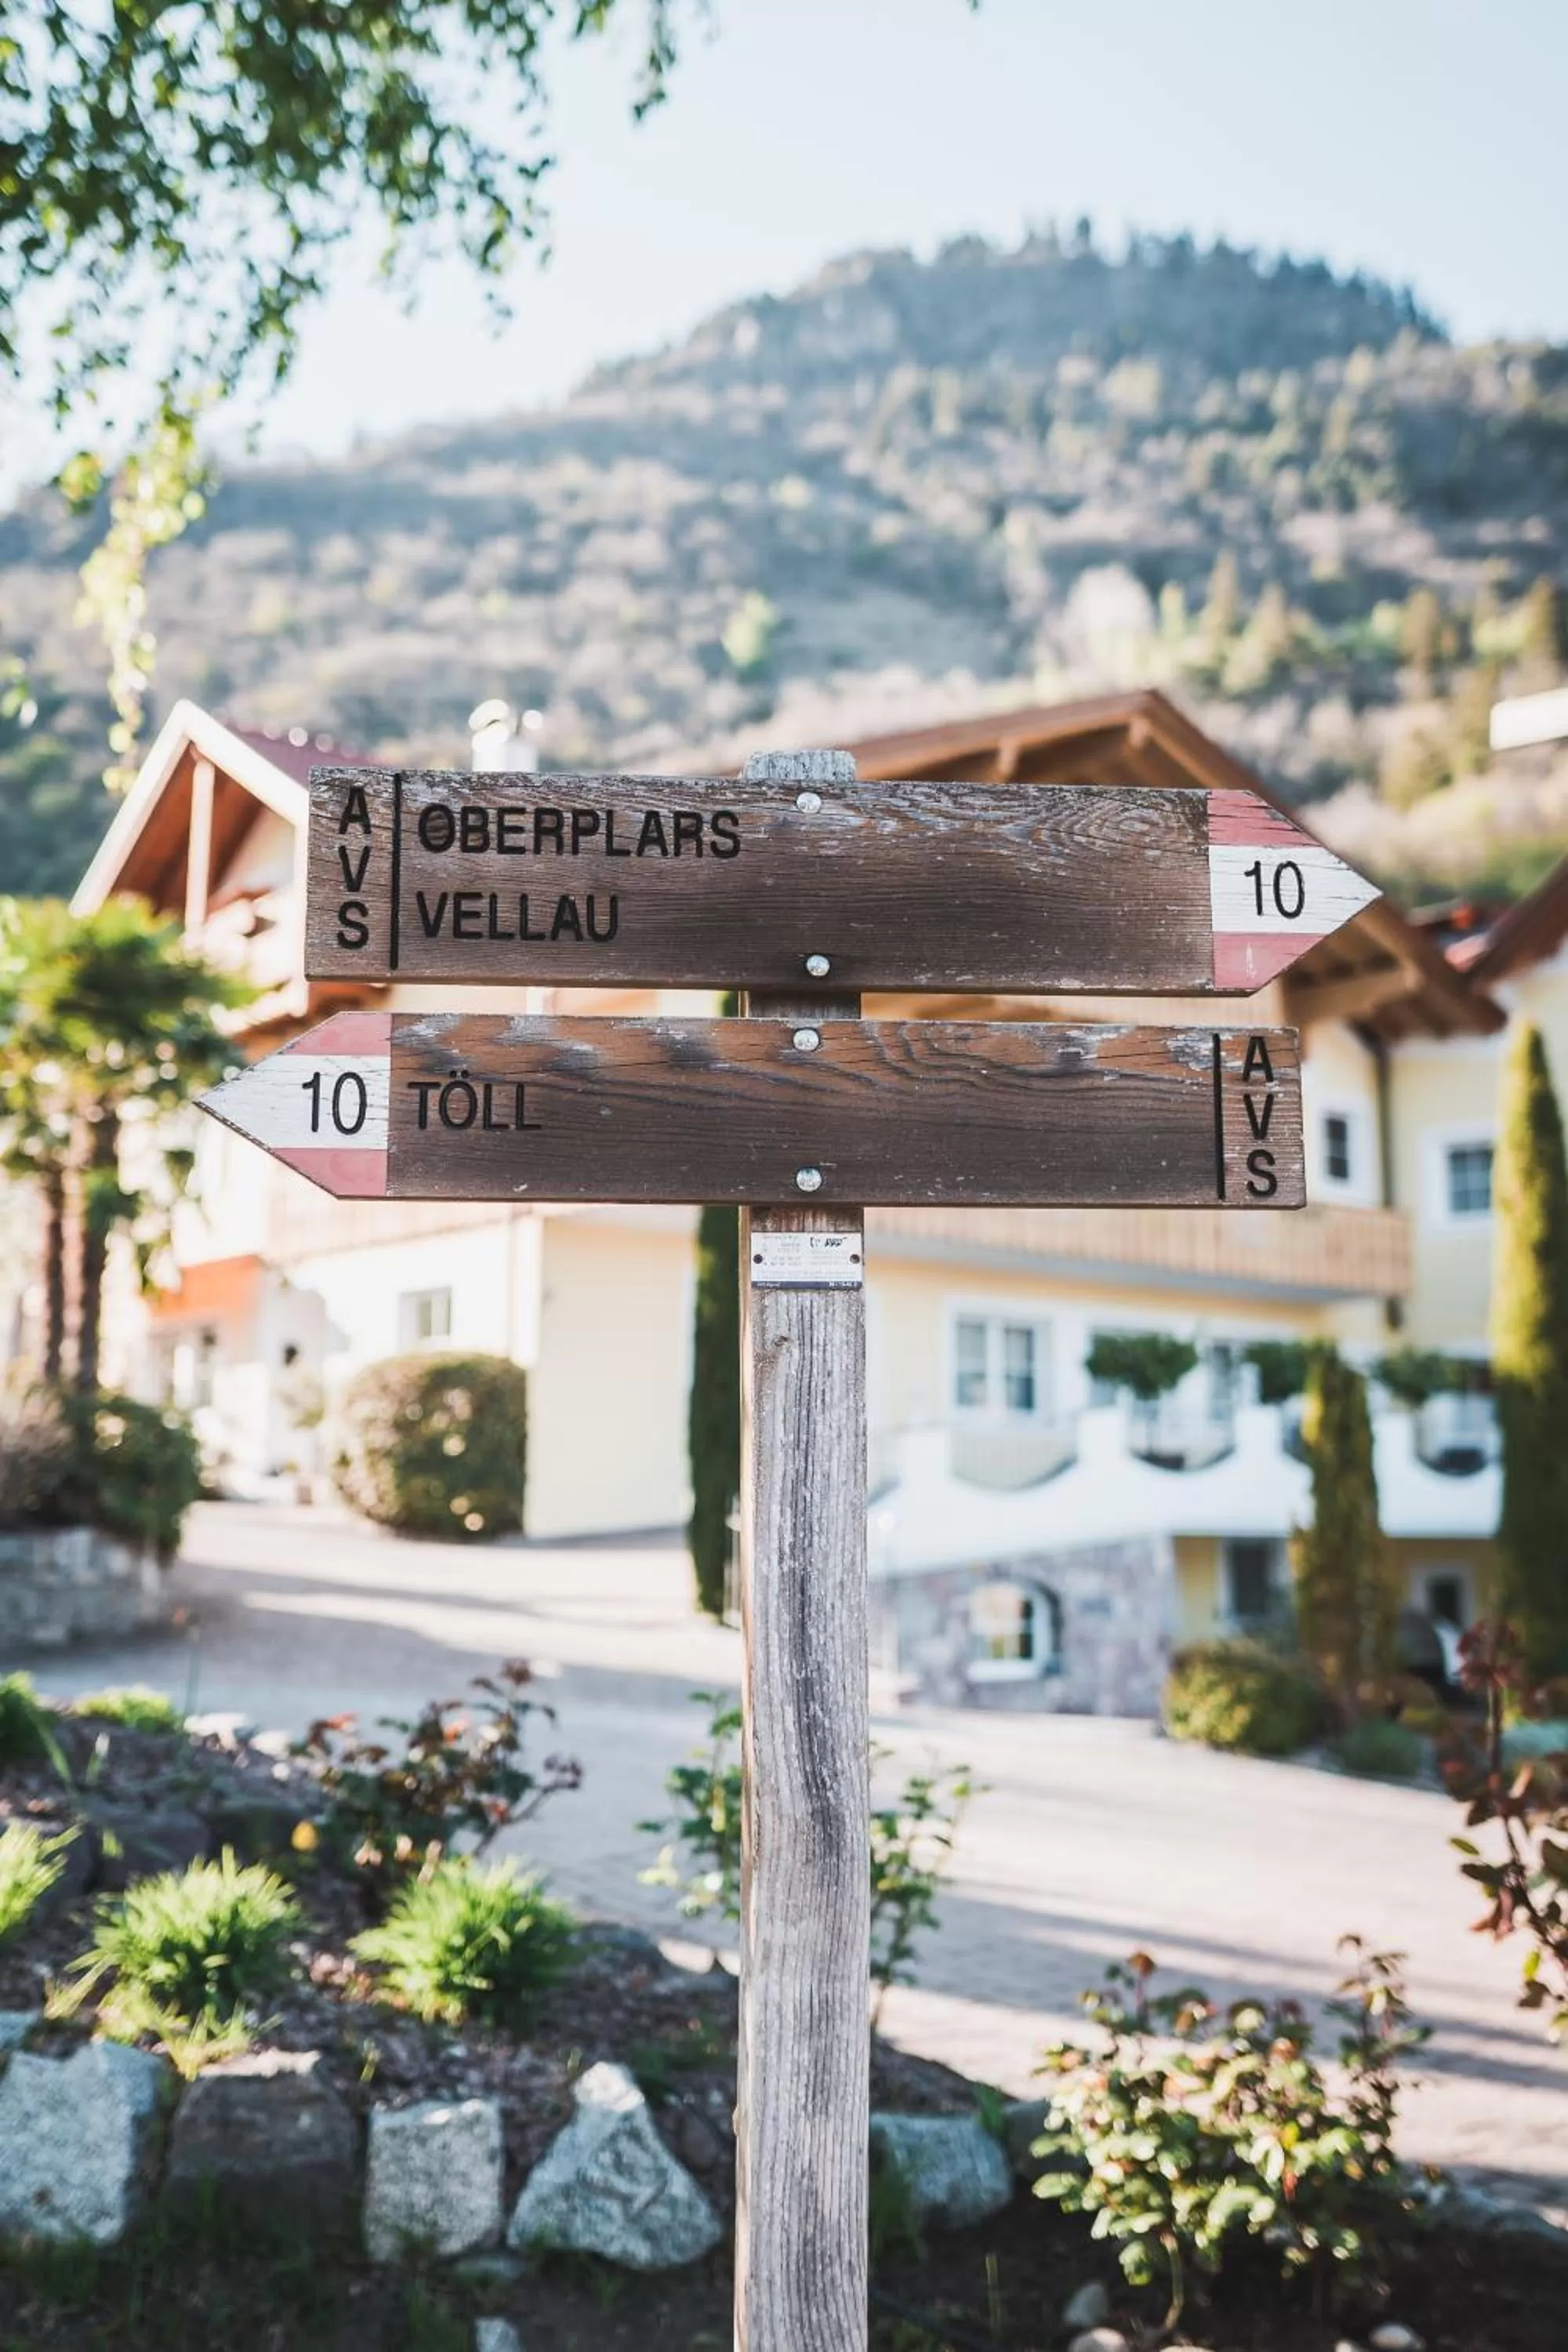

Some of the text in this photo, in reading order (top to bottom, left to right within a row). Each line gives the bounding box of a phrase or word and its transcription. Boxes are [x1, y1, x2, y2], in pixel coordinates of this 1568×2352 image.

[417, 804, 742, 859] OBERPLARS
[336, 785, 372, 950] AVS
[1243, 860, 1305, 919] 10
[416, 891, 620, 942] VELLAU
[301, 1071, 368, 1135] 10
[407, 1069, 543, 1131] TÖLL
[1242, 1036, 1279, 1198] AVS
